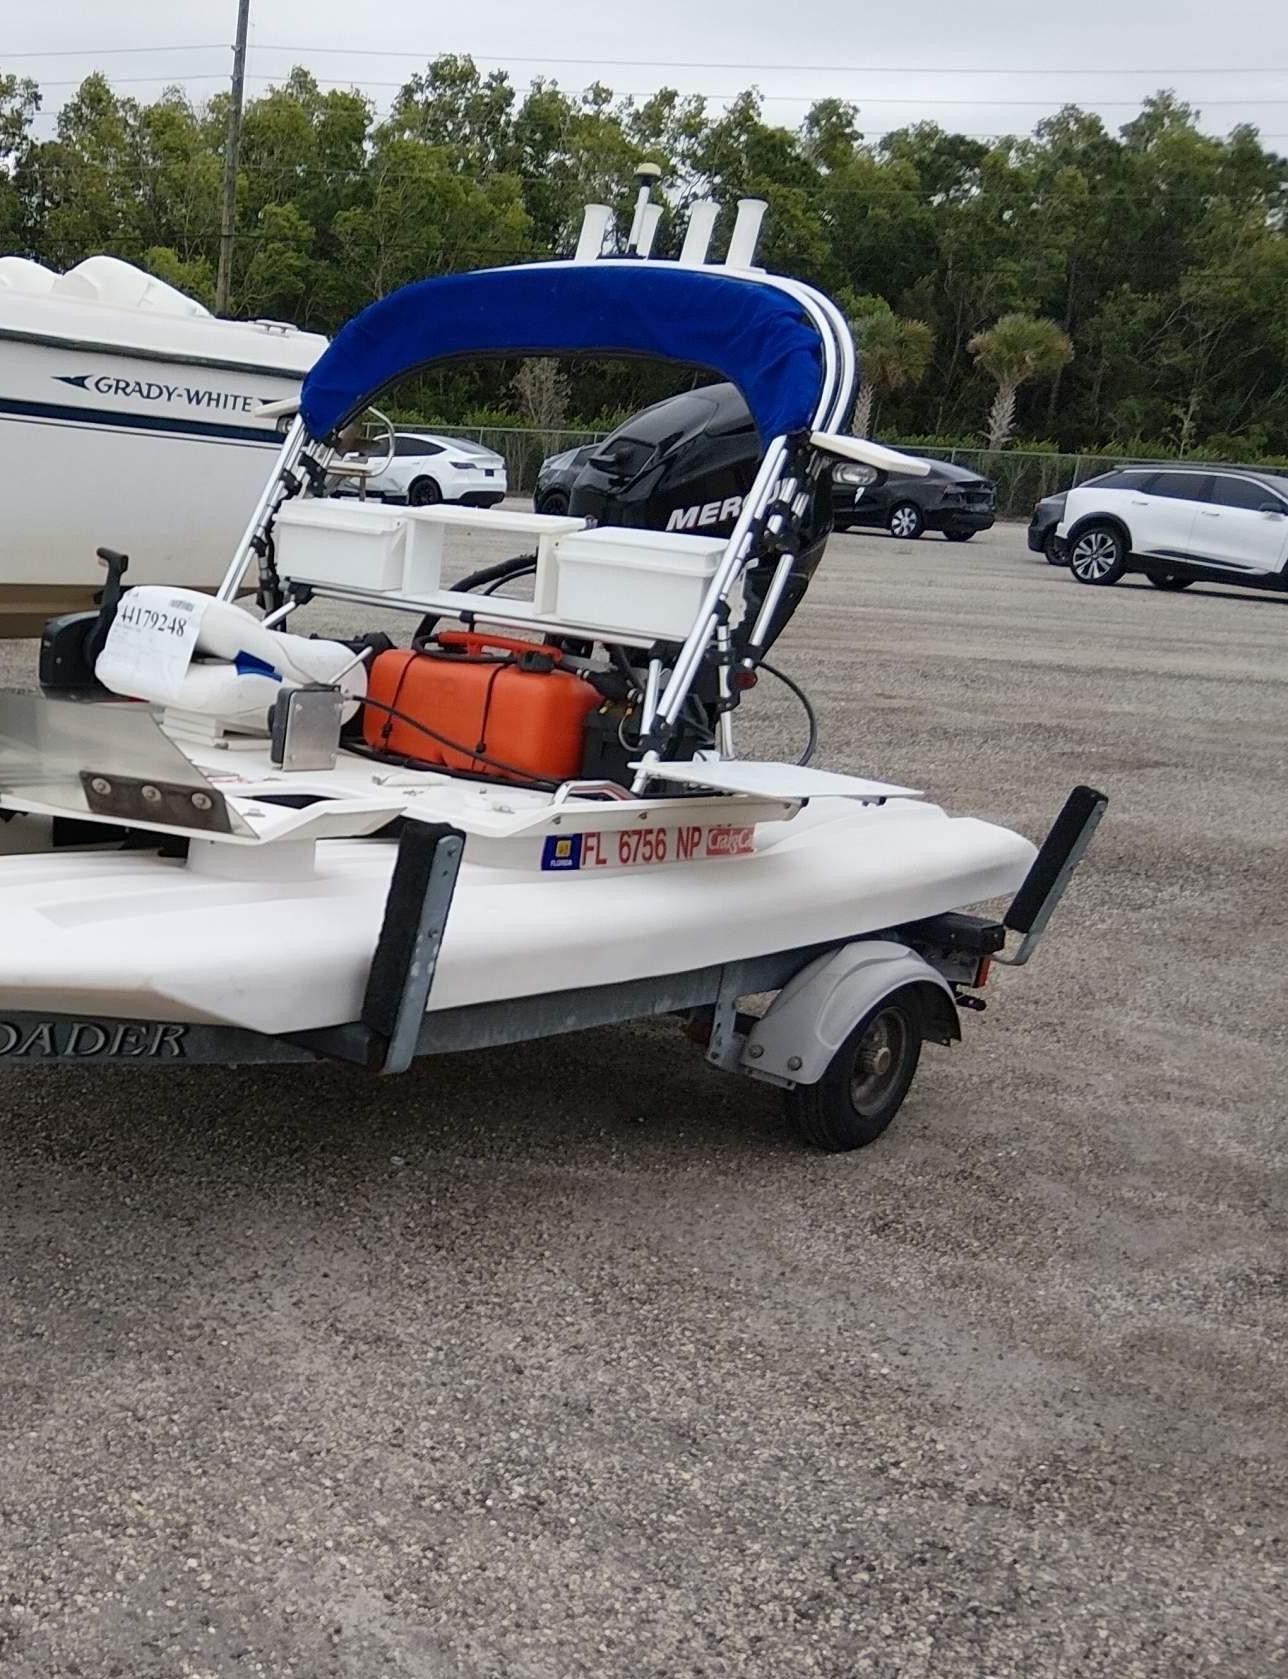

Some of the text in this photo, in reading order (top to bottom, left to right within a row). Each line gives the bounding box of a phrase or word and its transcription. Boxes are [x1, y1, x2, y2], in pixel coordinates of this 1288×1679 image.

[94, 375, 252, 413] GRADY-WHITE
[582, 826, 702, 866] FL 6756 NP
